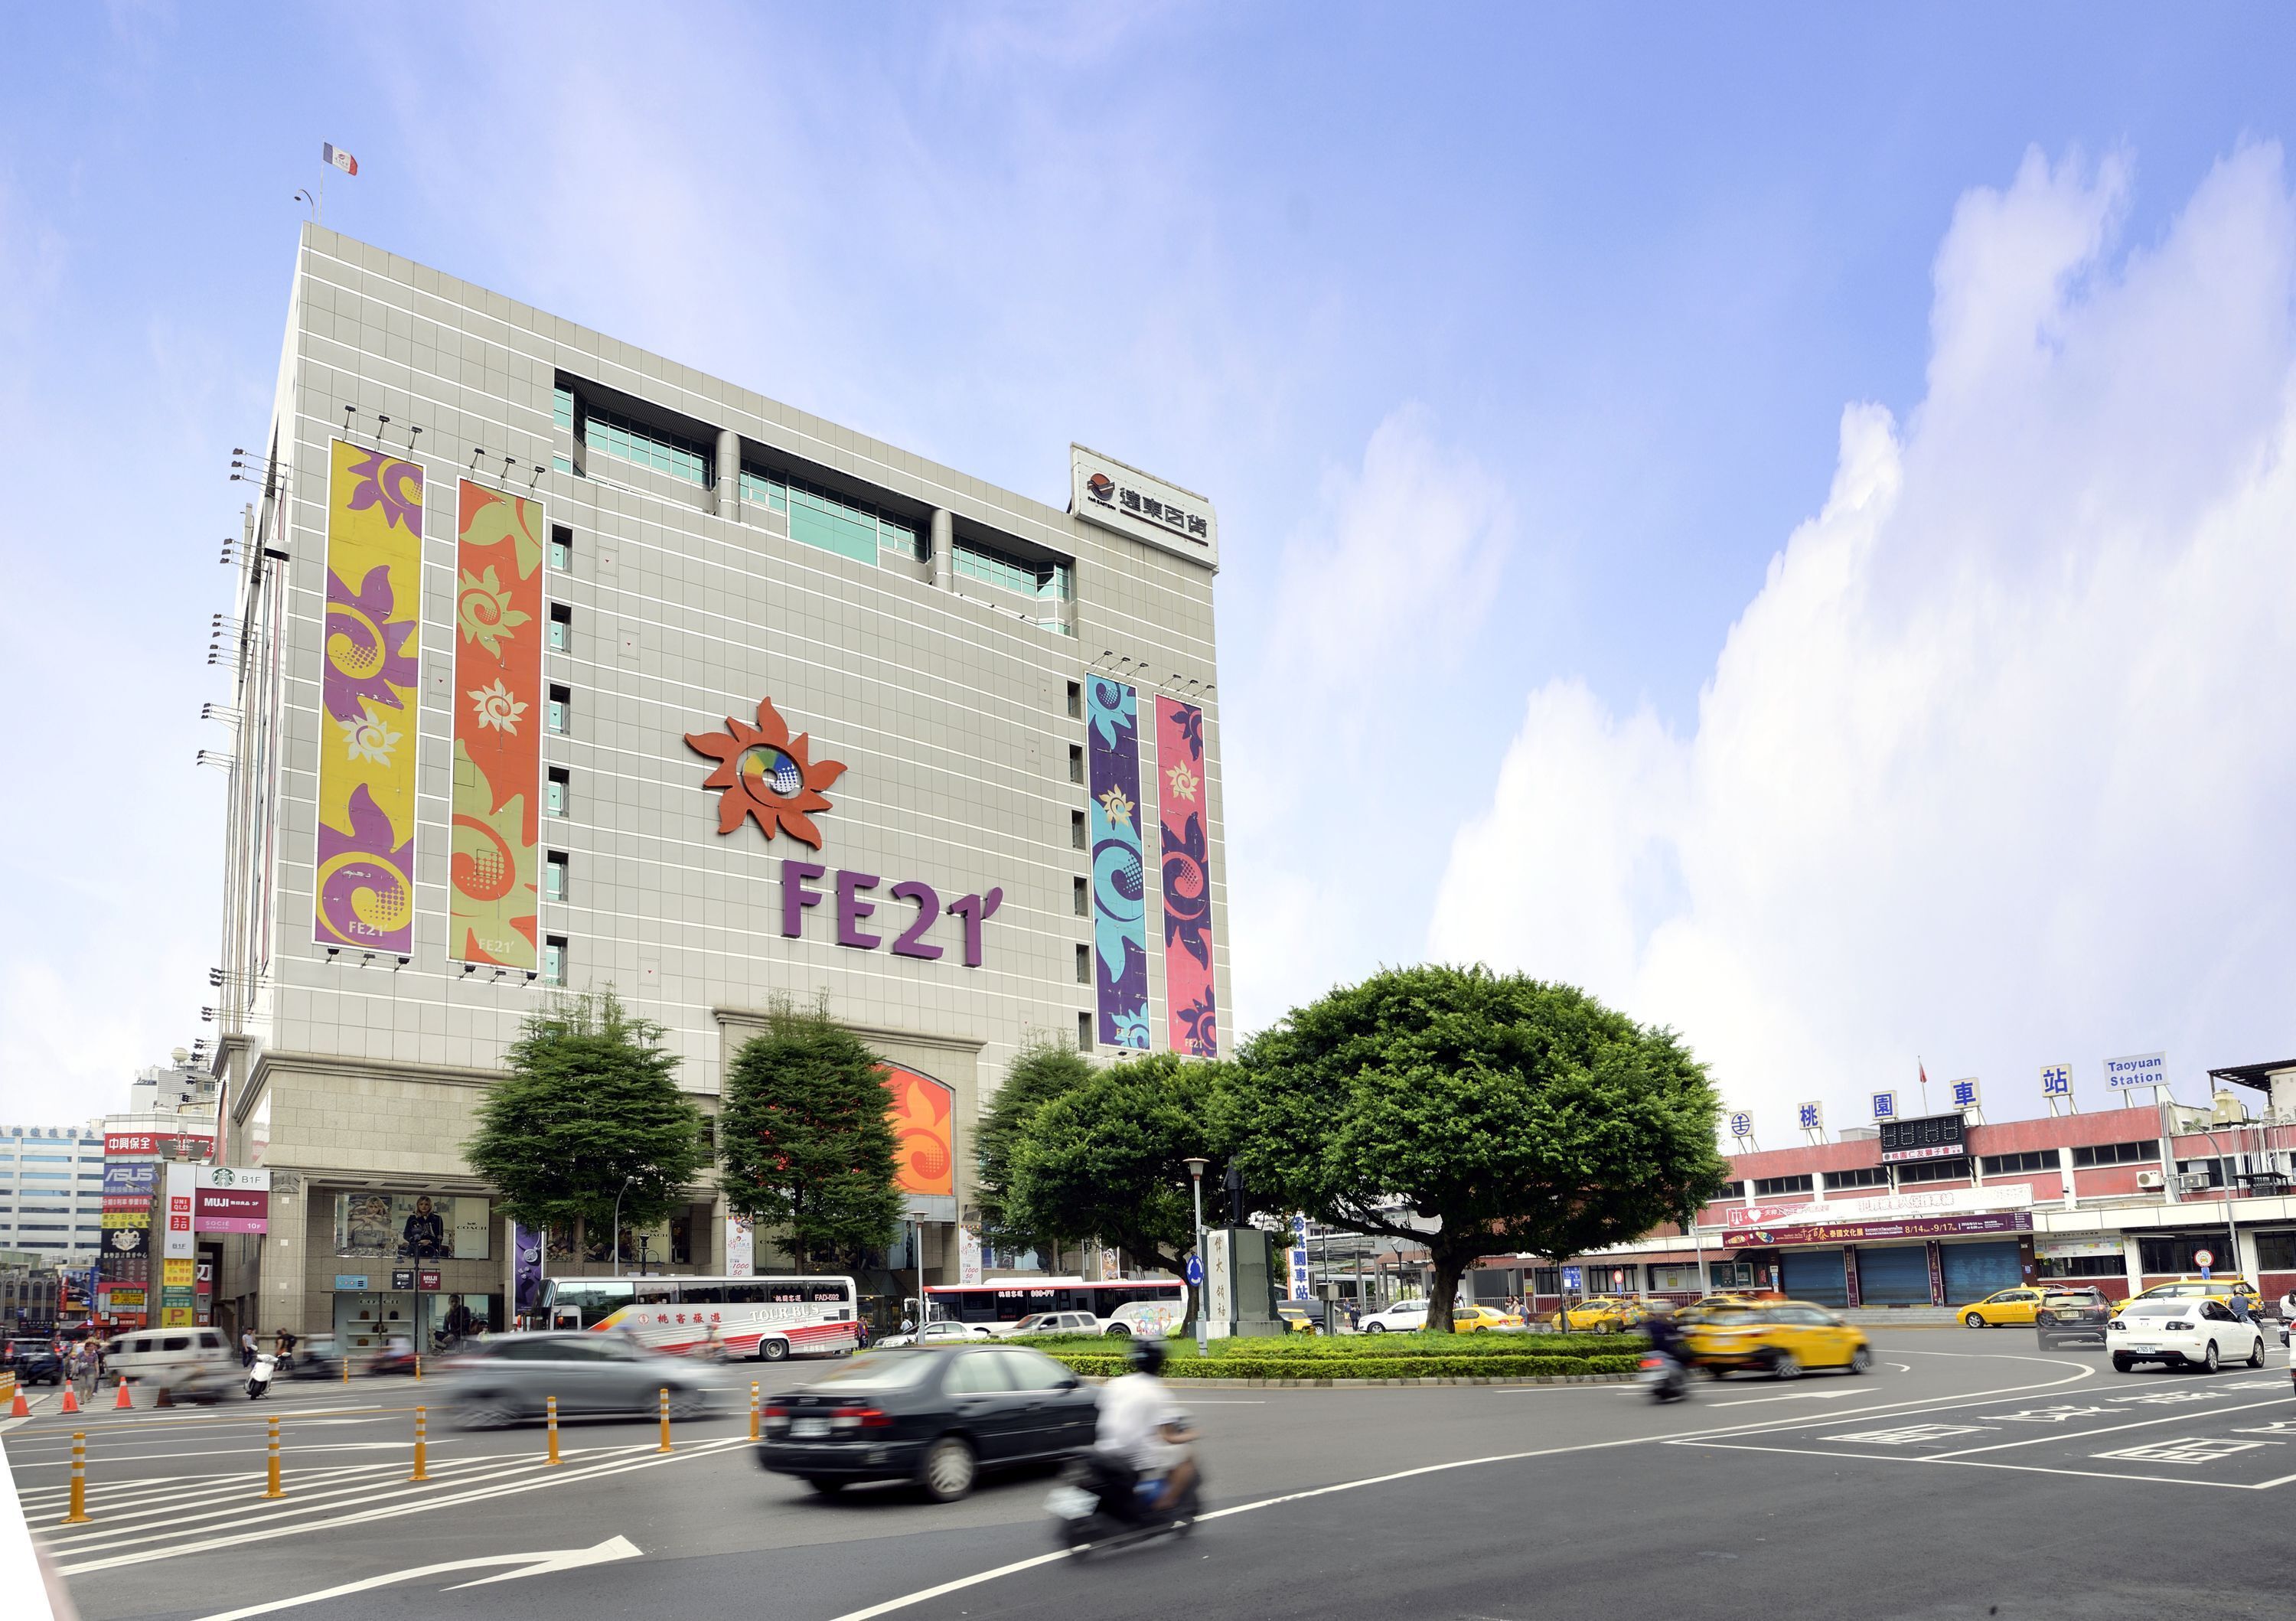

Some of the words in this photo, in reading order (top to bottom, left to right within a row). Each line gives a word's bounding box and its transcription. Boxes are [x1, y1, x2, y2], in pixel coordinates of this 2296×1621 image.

[1120, 488, 1208, 537] 遠東百貨
[2108, 1056, 2161, 1071] Taoyuan
[2110, 1071, 2163, 1087] Station
[109, 1137, 151, 1150] 中興保全
[105, 1168, 153, 1182] ASUS
[204, 1198, 230, 1207] MUJI
[1829, 1228, 1864, 1238] 泰國文化展
[1905, 1225, 1923, 1234] 8/14
[1214, 1236, 1226, 1316] 偉大領袖
[171, 1309, 185, 1323] P
[657, 1312, 722, 1324] 桃客旅遊
[750, 1307, 788, 1323] TOUR
[791, 1303, 820, 1317] BUS
